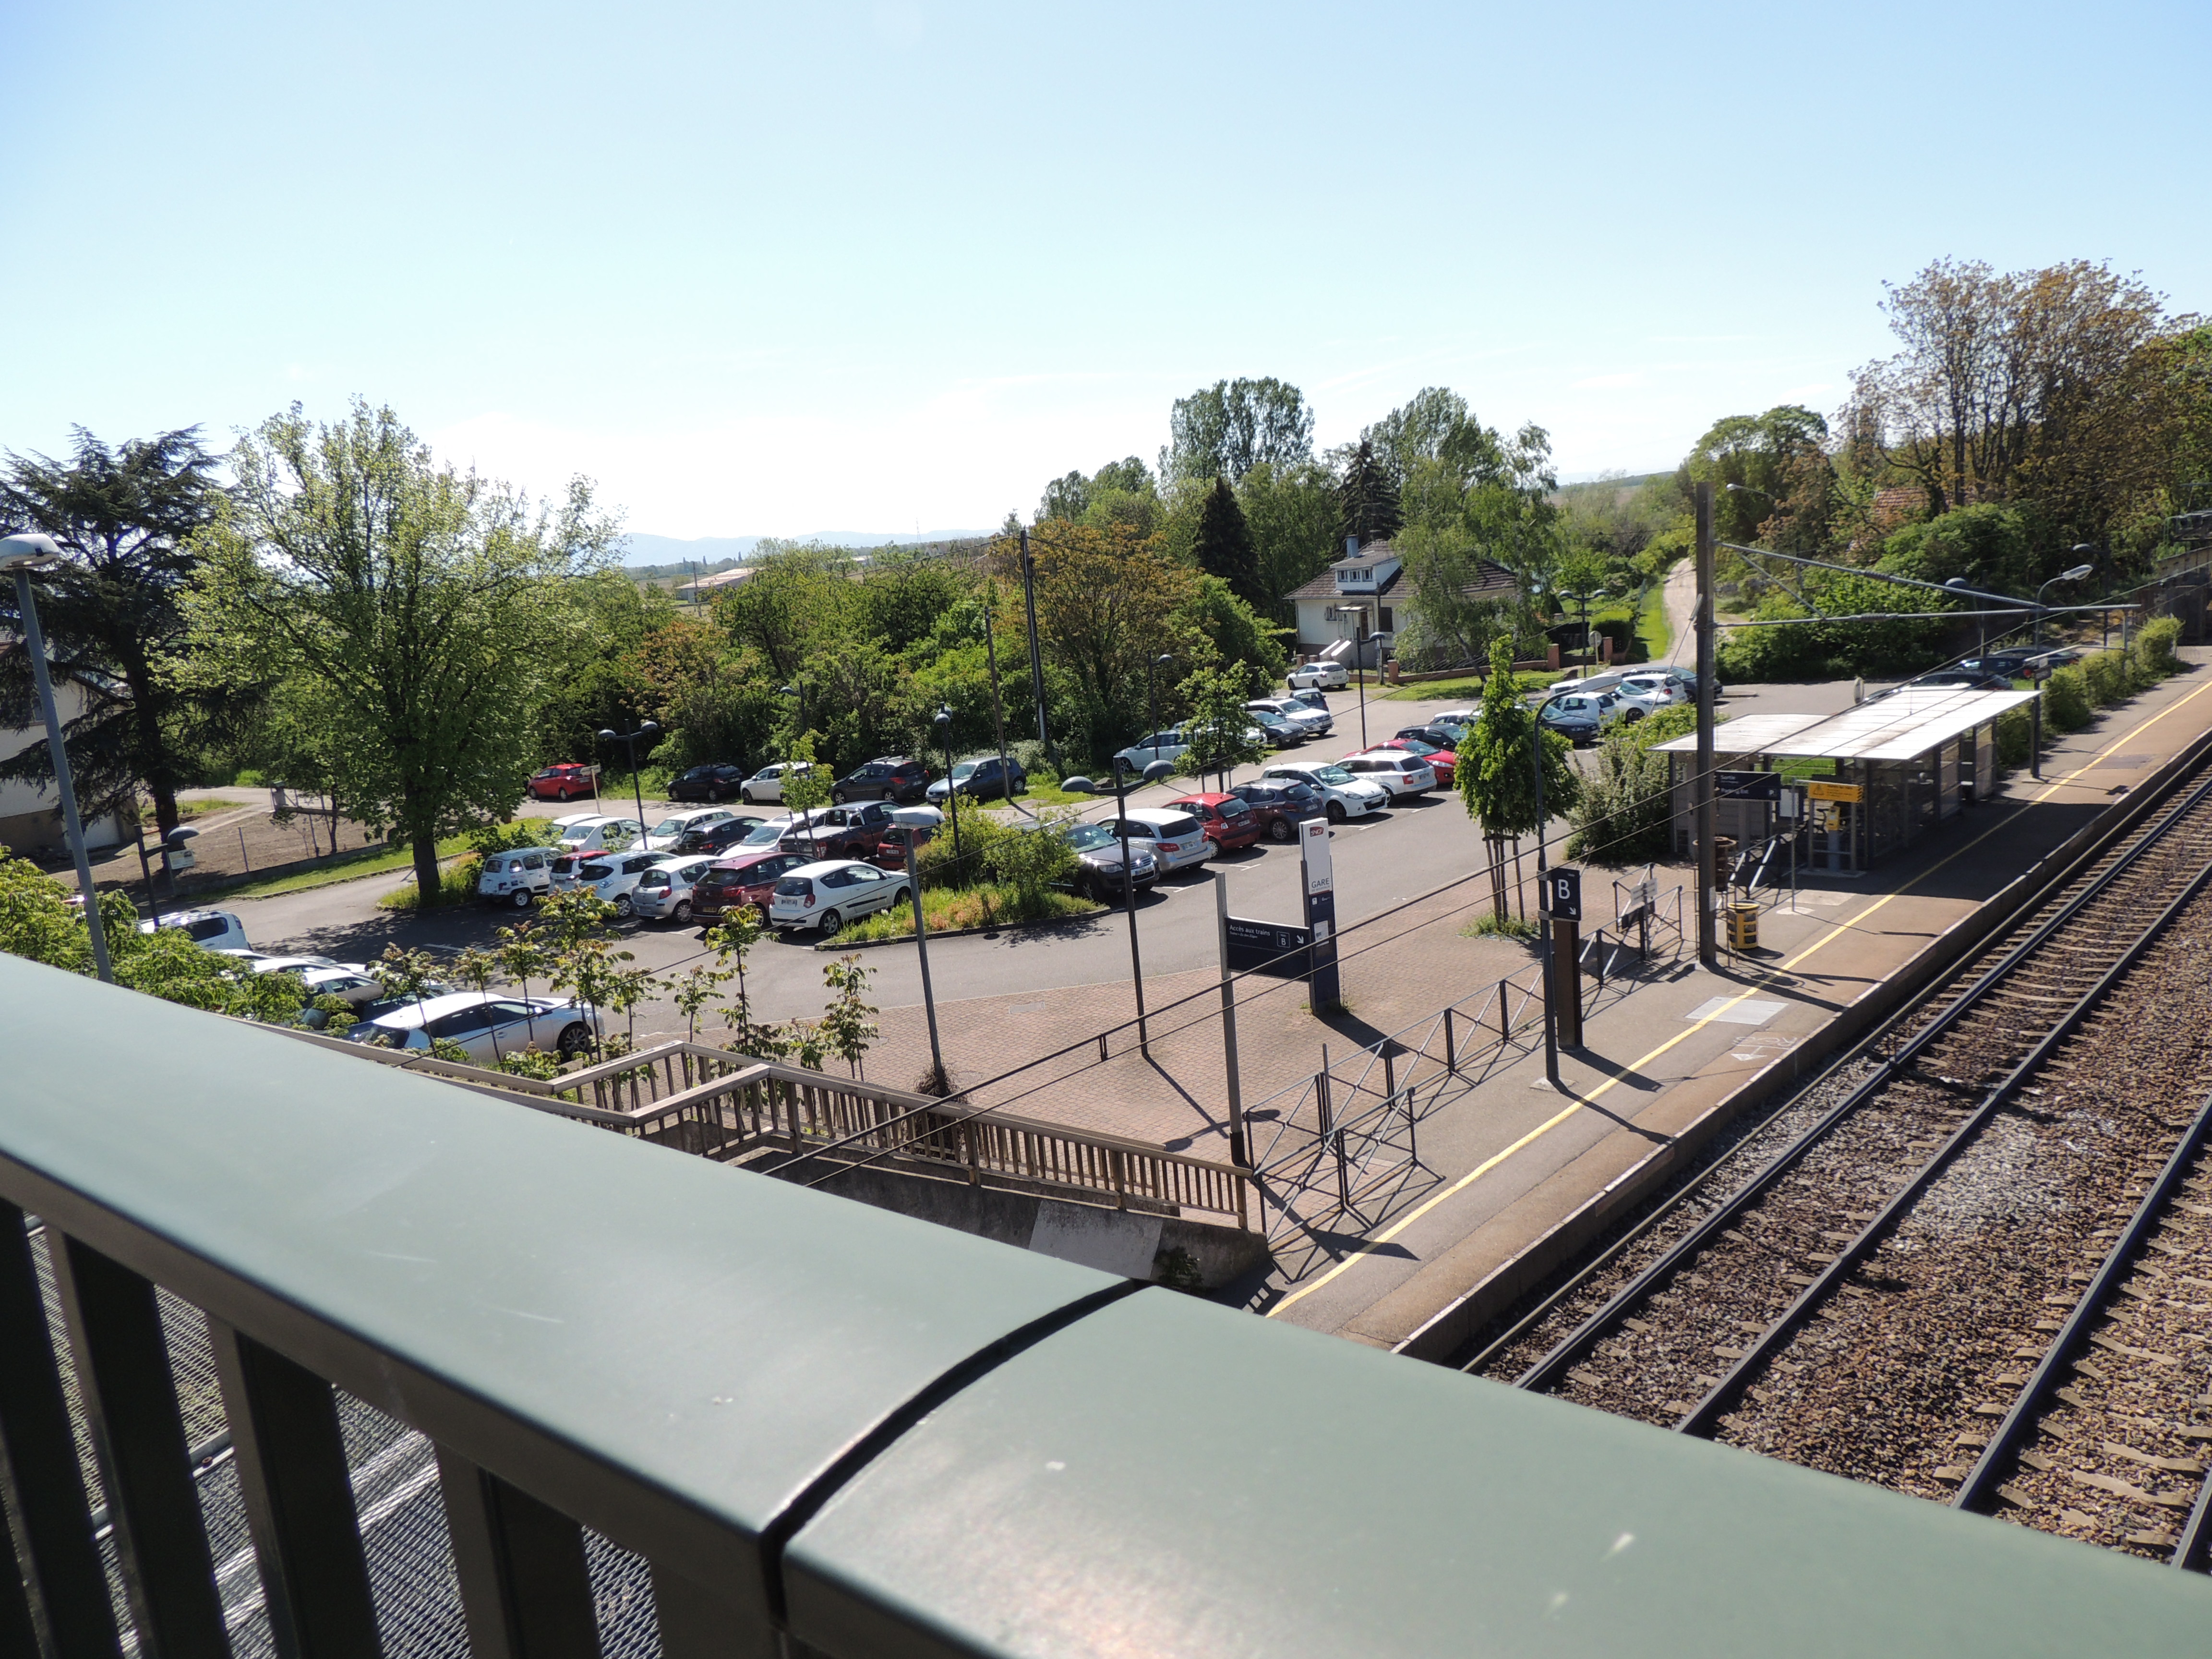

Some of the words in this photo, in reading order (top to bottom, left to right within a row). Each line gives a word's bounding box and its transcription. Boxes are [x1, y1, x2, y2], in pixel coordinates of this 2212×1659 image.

[1311, 878, 1329, 888] GARE
[1558, 879, 1570, 899] B
[1281, 938, 1286, 946] B
